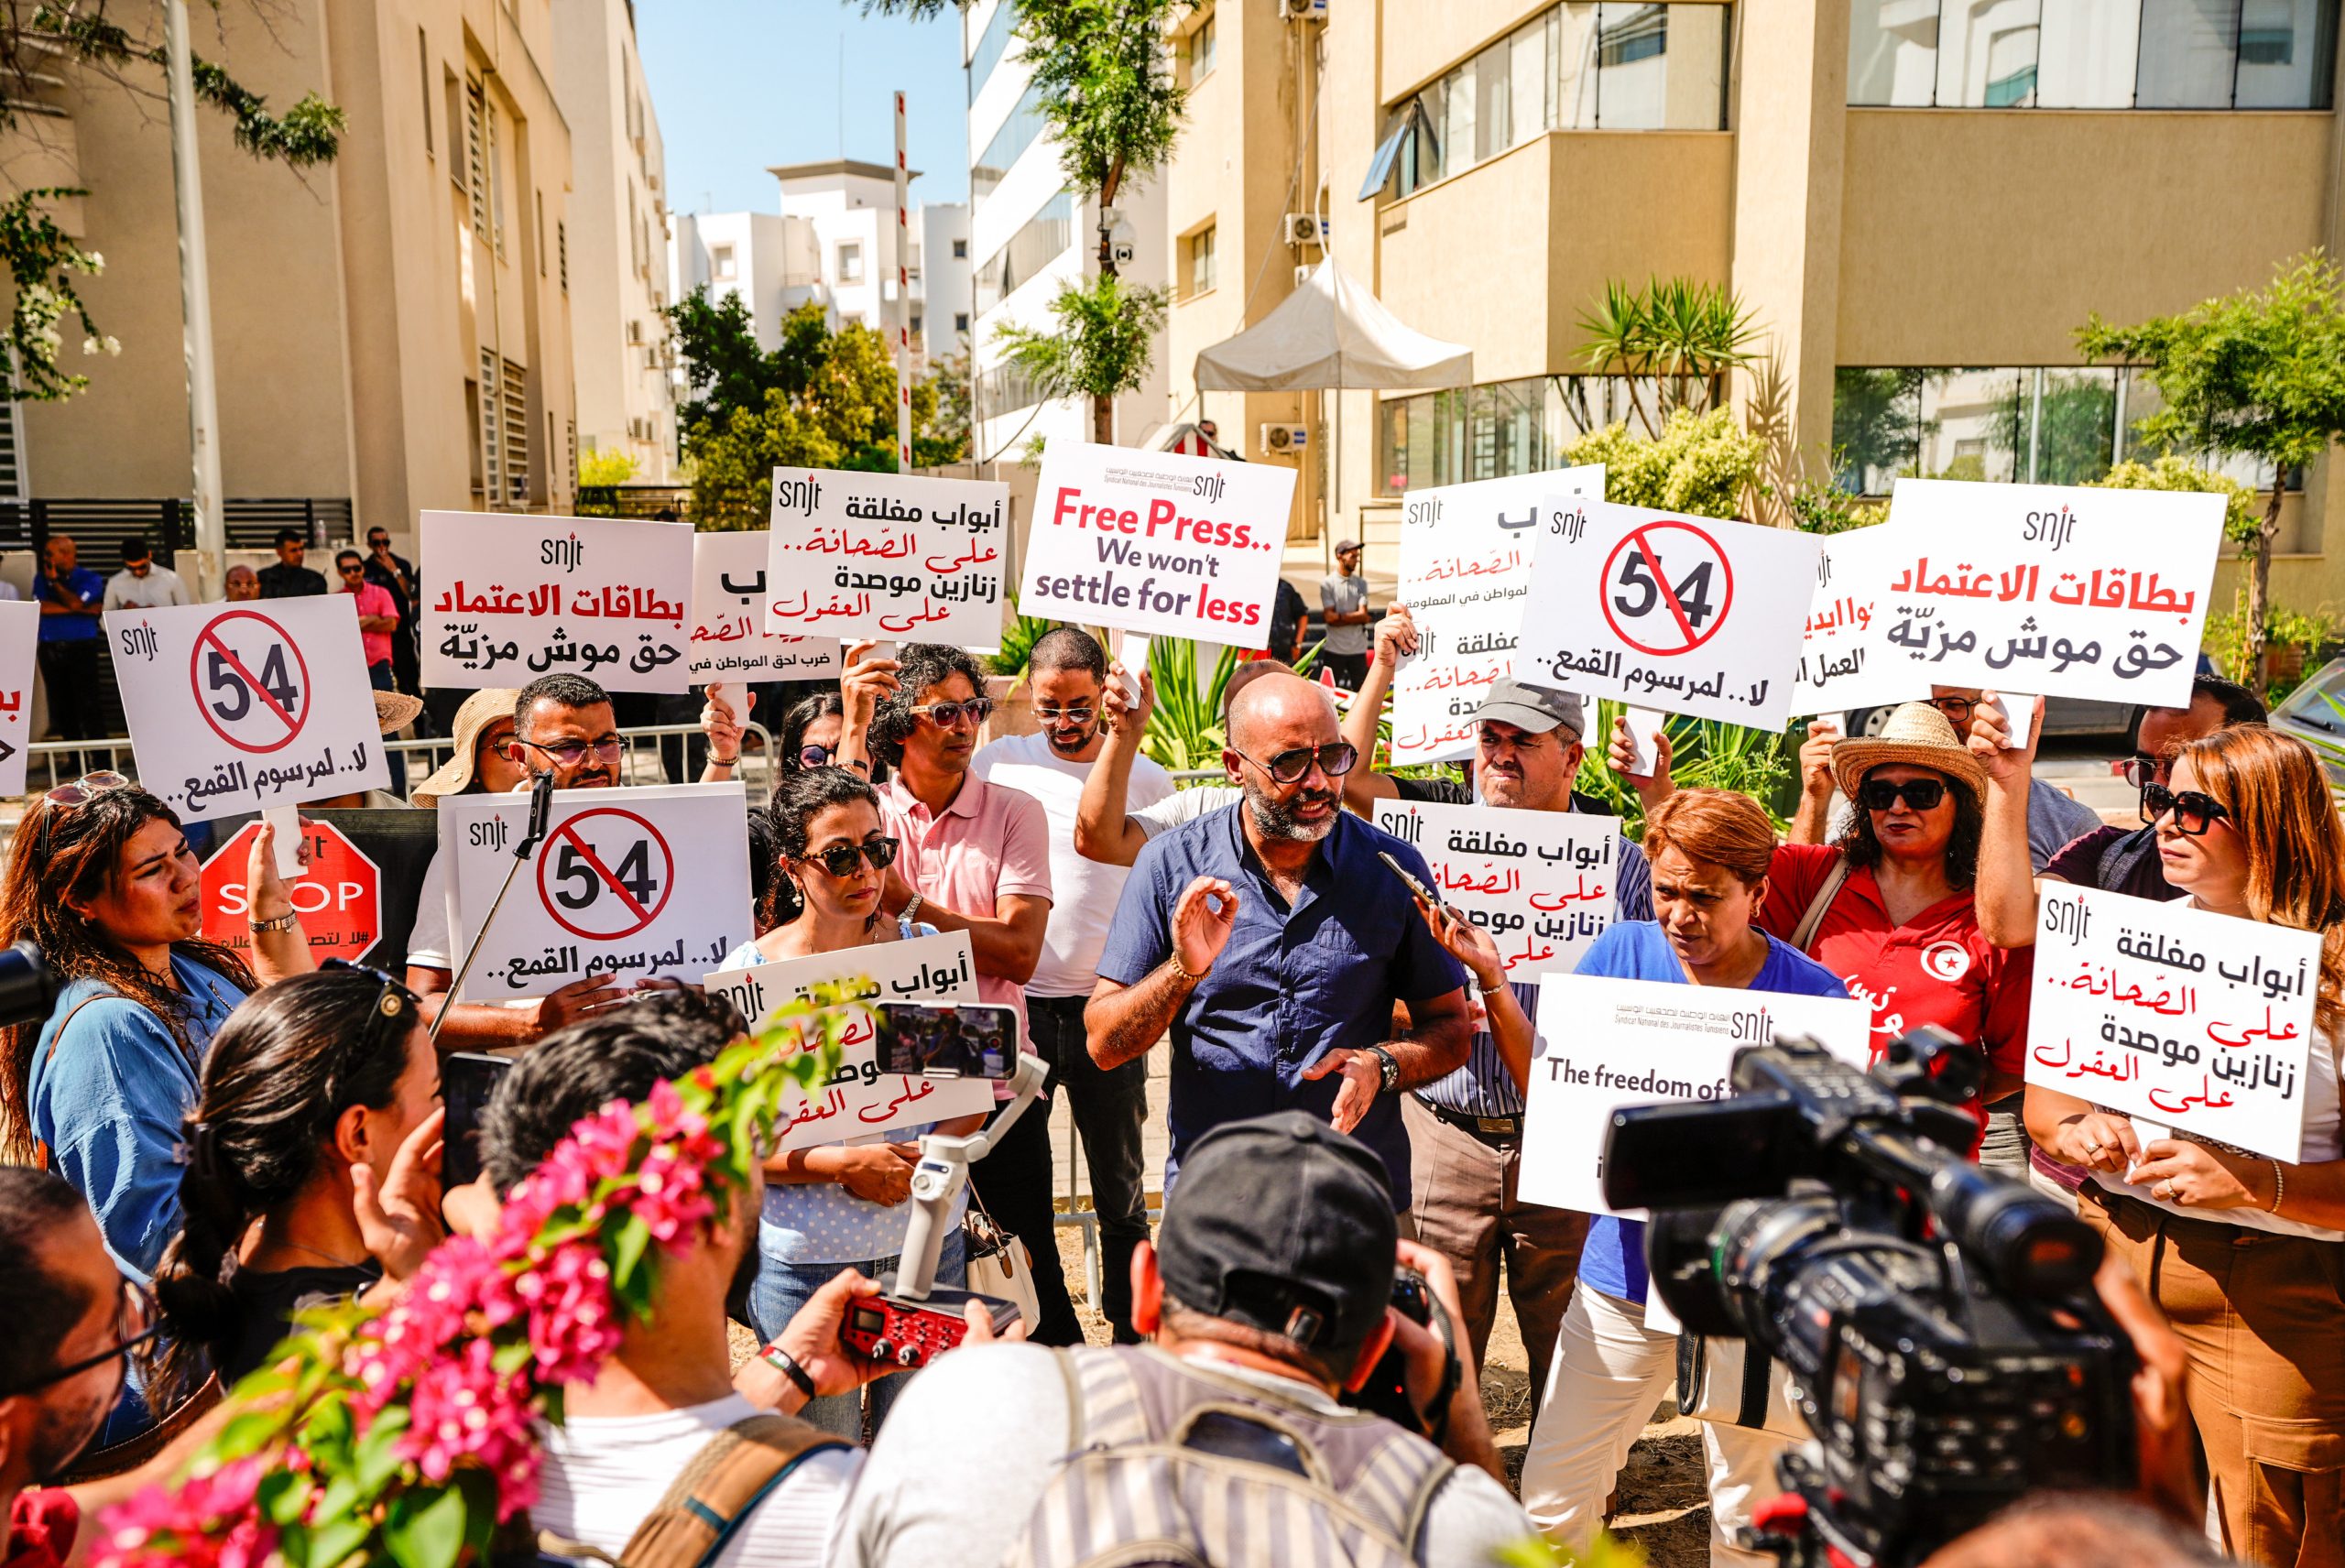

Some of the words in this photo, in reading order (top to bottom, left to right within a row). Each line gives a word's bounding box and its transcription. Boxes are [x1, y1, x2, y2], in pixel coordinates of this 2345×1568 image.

[779, 474, 823, 517] snjt
[845, 495, 922, 523] مغلقة
[1193, 473, 1226, 505] snjt
[932, 499, 1001, 534] أبواب
[1053, 486, 1139, 534] Free
[1145, 498, 1271, 551] Press..
[1408, 499, 1444, 528] snjt
[1551, 509, 1587, 544] snjt
[2023, 505, 2077, 552] snjt
[540, 532, 584, 573] snjt
[924, 537, 998, 574] على
[1096, 536, 1142, 567] We
[1148, 552, 1220, 578] won't
[434, 580, 561, 617] الاعتماد
[834, 565, 922, 598] موصدة
[930, 572, 997, 604] زنازين
[1034, 570, 1130, 608] settle
[1138, 577, 1192, 615] for
[1196, 583, 1261, 626] less
[1459, 591, 1479, 606] في
[1482, 584, 1528, 602] لمواطن
[1614, 550, 1713, 627] 54
[1890, 557, 2040, 602] الاعتماد
[2049, 568, 2195, 626] بطاقات
[571, 584, 683, 630] بطاقات
[772, 589, 870, 623] العقول
[878, 595, 954, 633] على
[121, 619, 158, 662] snjt
[527, 626, 620, 673] موش
[629, 634, 682, 674] حق
[1984, 615, 2102, 673] موش
[2112, 629, 2184, 680] حق
[689, 660, 712, 672] في
[715, 655, 768, 671] المواطن
[772, 653, 797, 670] لحق
[801, 656, 831, 668] ضرب
[1536, 648, 1622, 681] القمع..
[207, 643, 299, 723] 54
[1623, 667, 1725, 702] لمرسوم
[1728, 680, 1769, 707] لا..
[253, 746, 335, 800] لمرسوم
[340, 741, 367, 773] لا..
[167, 760, 248, 812] القمع..
[469, 813, 508, 853] snjt
[1447, 829, 1528, 858] مغلقة
[1537, 834, 1610, 871] أبواب
[555, 839, 657, 910] 54
[1529, 874, 1607, 911] على
[218, 882, 364, 914] SOP
[2045, 895, 2092, 947] snjt
[486, 945, 579, 989] القمع..
[584, 938, 685, 978] لمرسوم
[691, 935, 727, 964] لا..
[2117, 927, 2206, 974] مغلقة
[891, 950, 968, 996] أبواب
[2218, 955, 2307, 1002] أبواب
[1638, 1017, 1659, 1028] National
[1660, 1019, 1669, 1029] des
[2100, 1013, 2200, 1068] موصدة
[2207, 1006, 2299, 1048] على
[1547, 1056, 1590, 1085] The
[1594, 1063, 1692, 1099] freedom
[1697, 1078, 1726, 1102] of
[2034, 1039, 2139, 1082] العقول
[2211, 1047, 2295, 1100] زنازين
[857, 1074, 935, 1124] على
[2148, 1074, 2234, 1114] على
